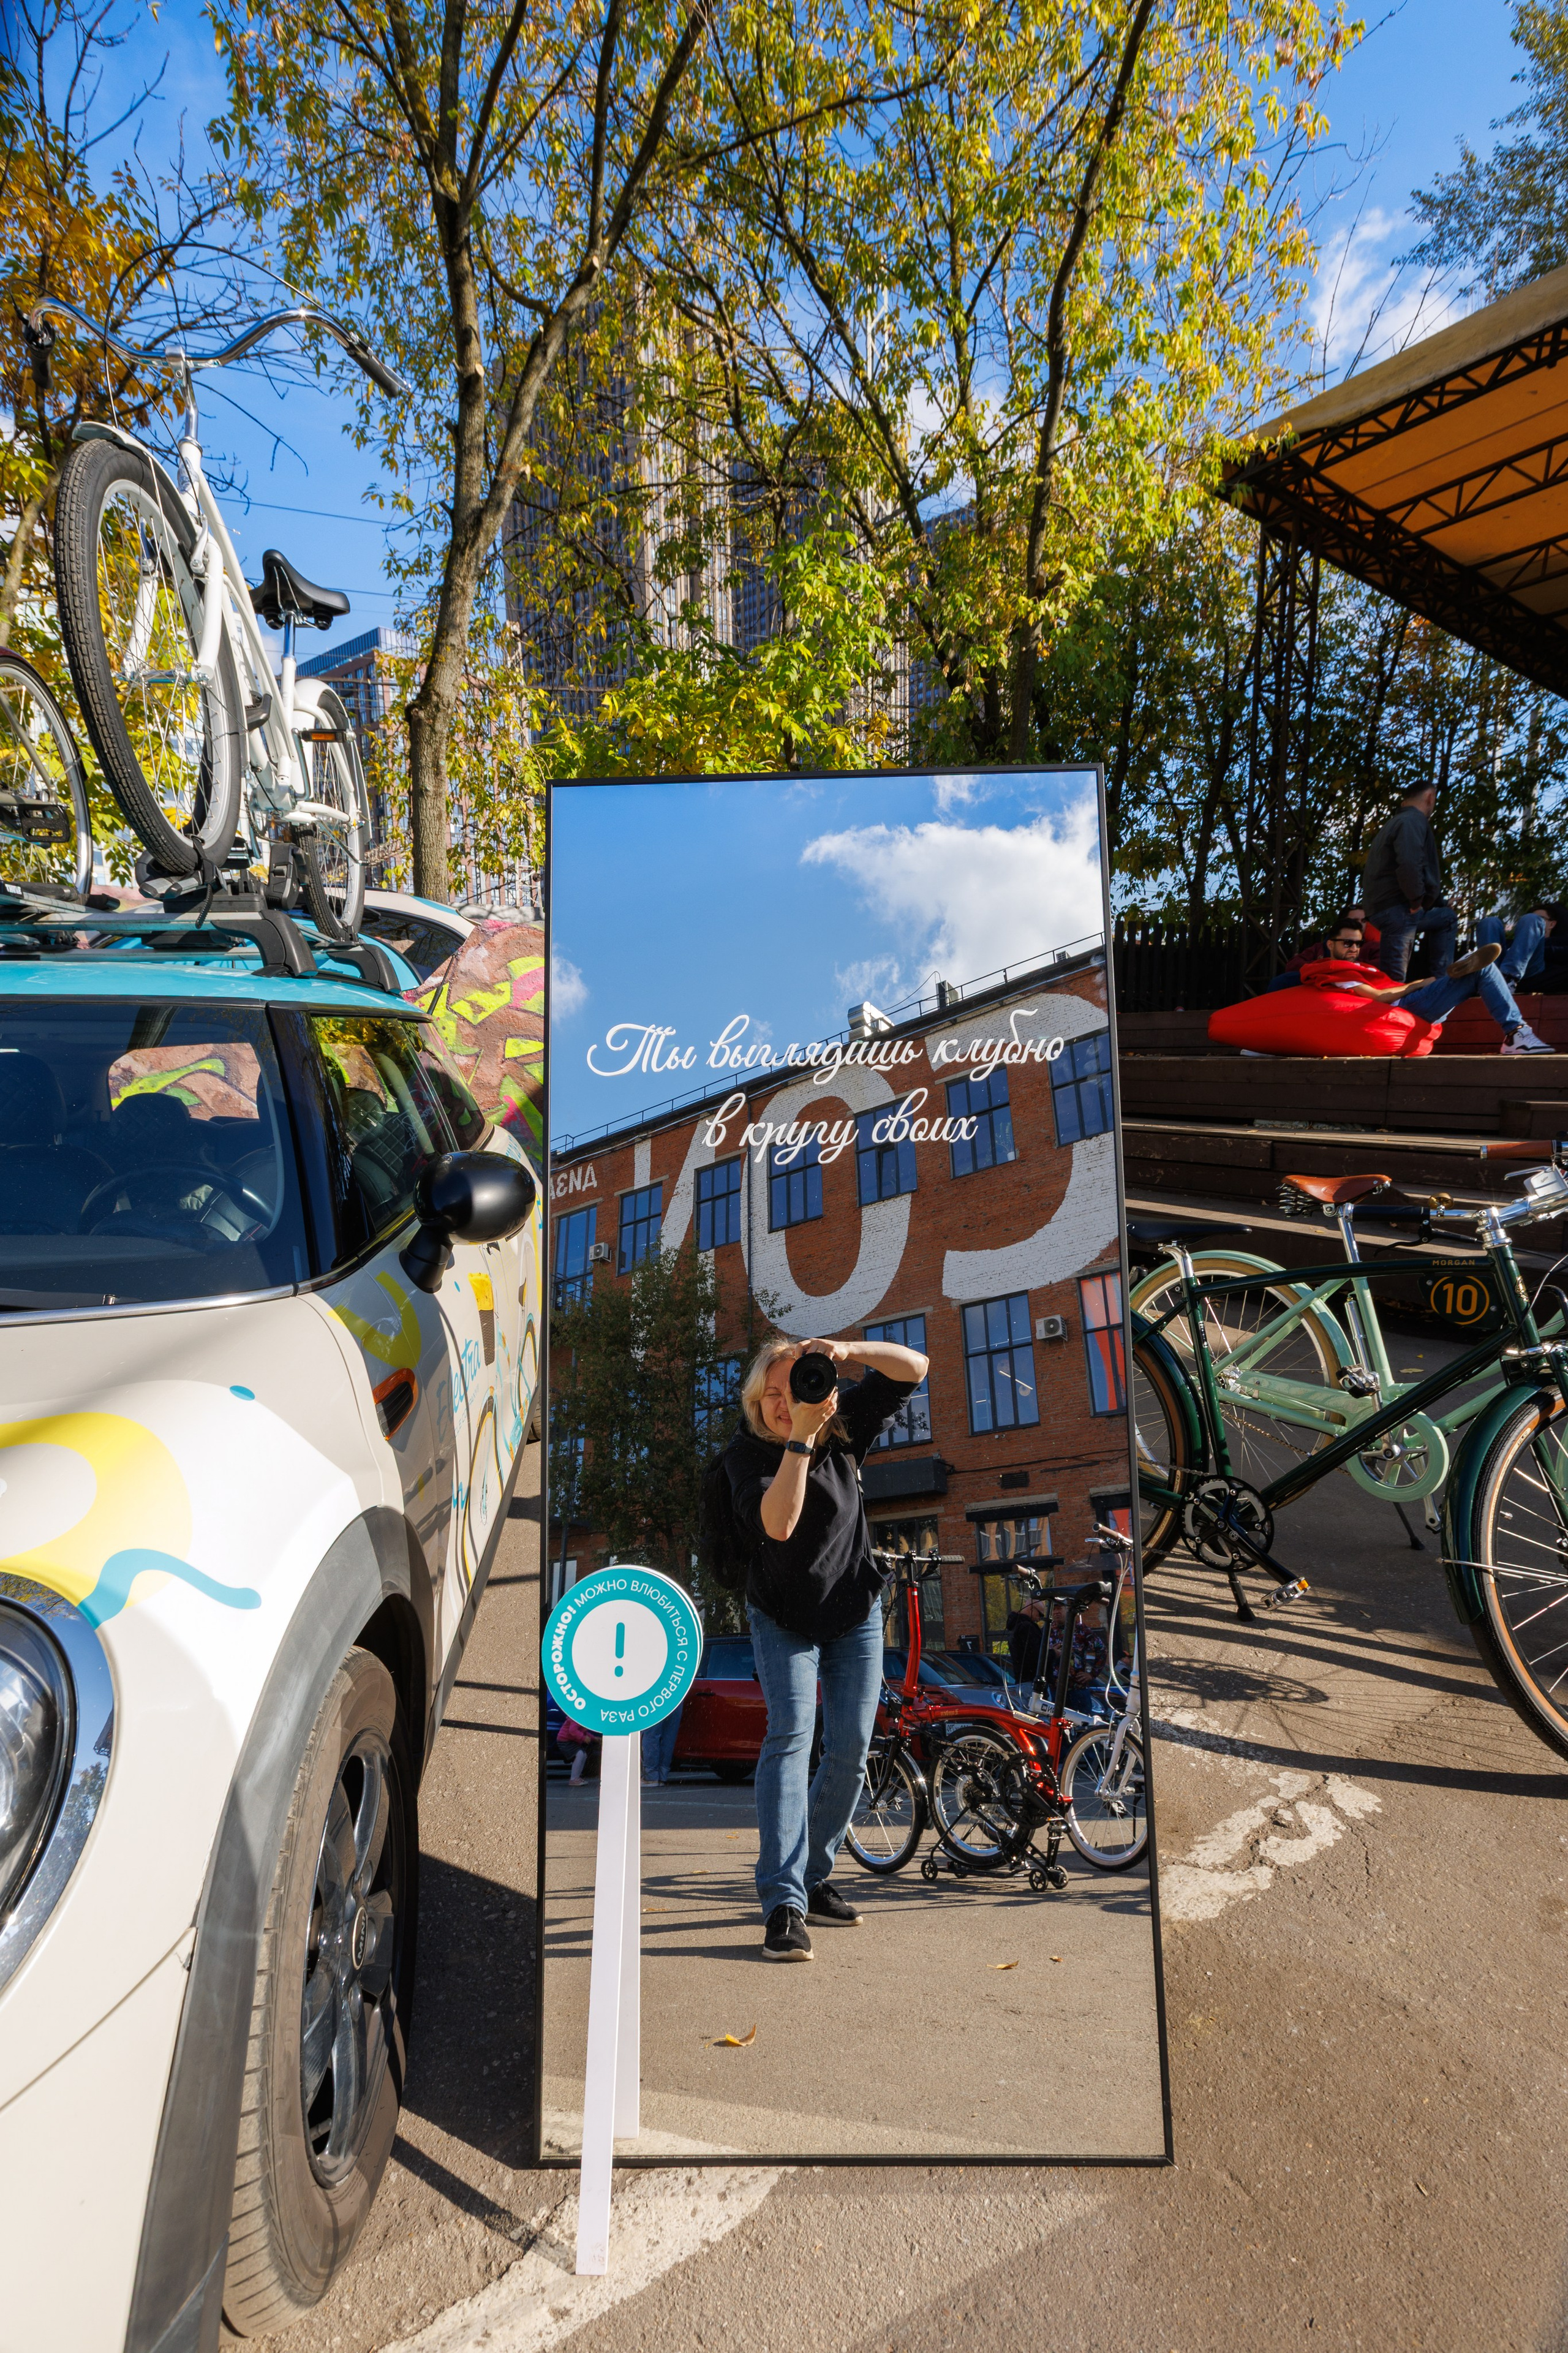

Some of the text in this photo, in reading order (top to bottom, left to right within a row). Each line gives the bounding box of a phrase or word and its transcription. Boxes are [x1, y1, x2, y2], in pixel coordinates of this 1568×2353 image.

[587, 1008, 1065, 1085] Ты выглядишь клубно
[701, 1087, 979, 1165] в кругу своих
[1442, 1283, 1478, 1316] 10
[435, 1338, 482, 1444] Electra
[551, 1579, 688, 1723] ОСТОРОЖНО! МОЖНО ВЛЮБИТЬСЯ С ПЕРВОГО РАЗА
[357, 1915, 366, 1960] MINI
